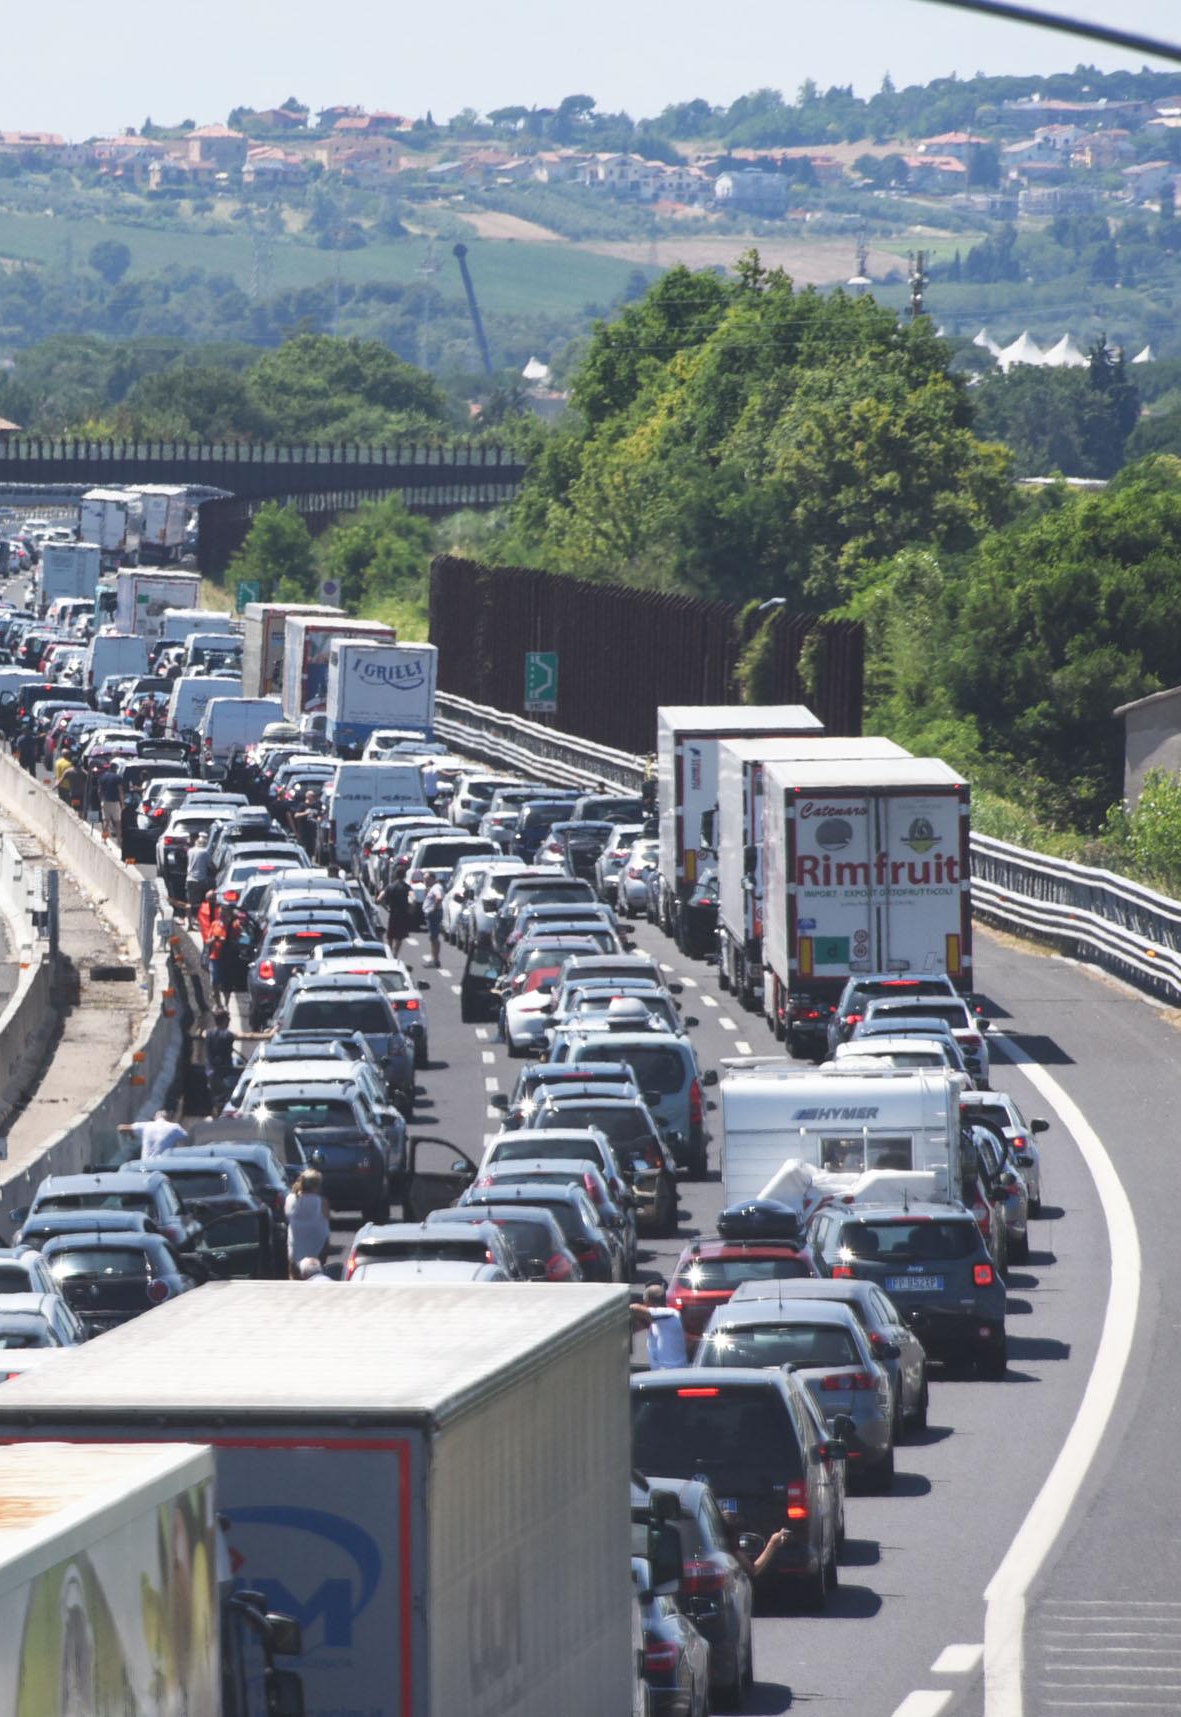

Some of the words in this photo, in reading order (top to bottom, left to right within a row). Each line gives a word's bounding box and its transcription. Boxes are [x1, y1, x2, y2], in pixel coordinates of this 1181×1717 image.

[797, 852, 959, 886] Rimfruit
[804, 890, 837, 899] IMPORT
[844, 889, 877, 898] EXPORT
[818, 1106, 880, 1120] HYMER
